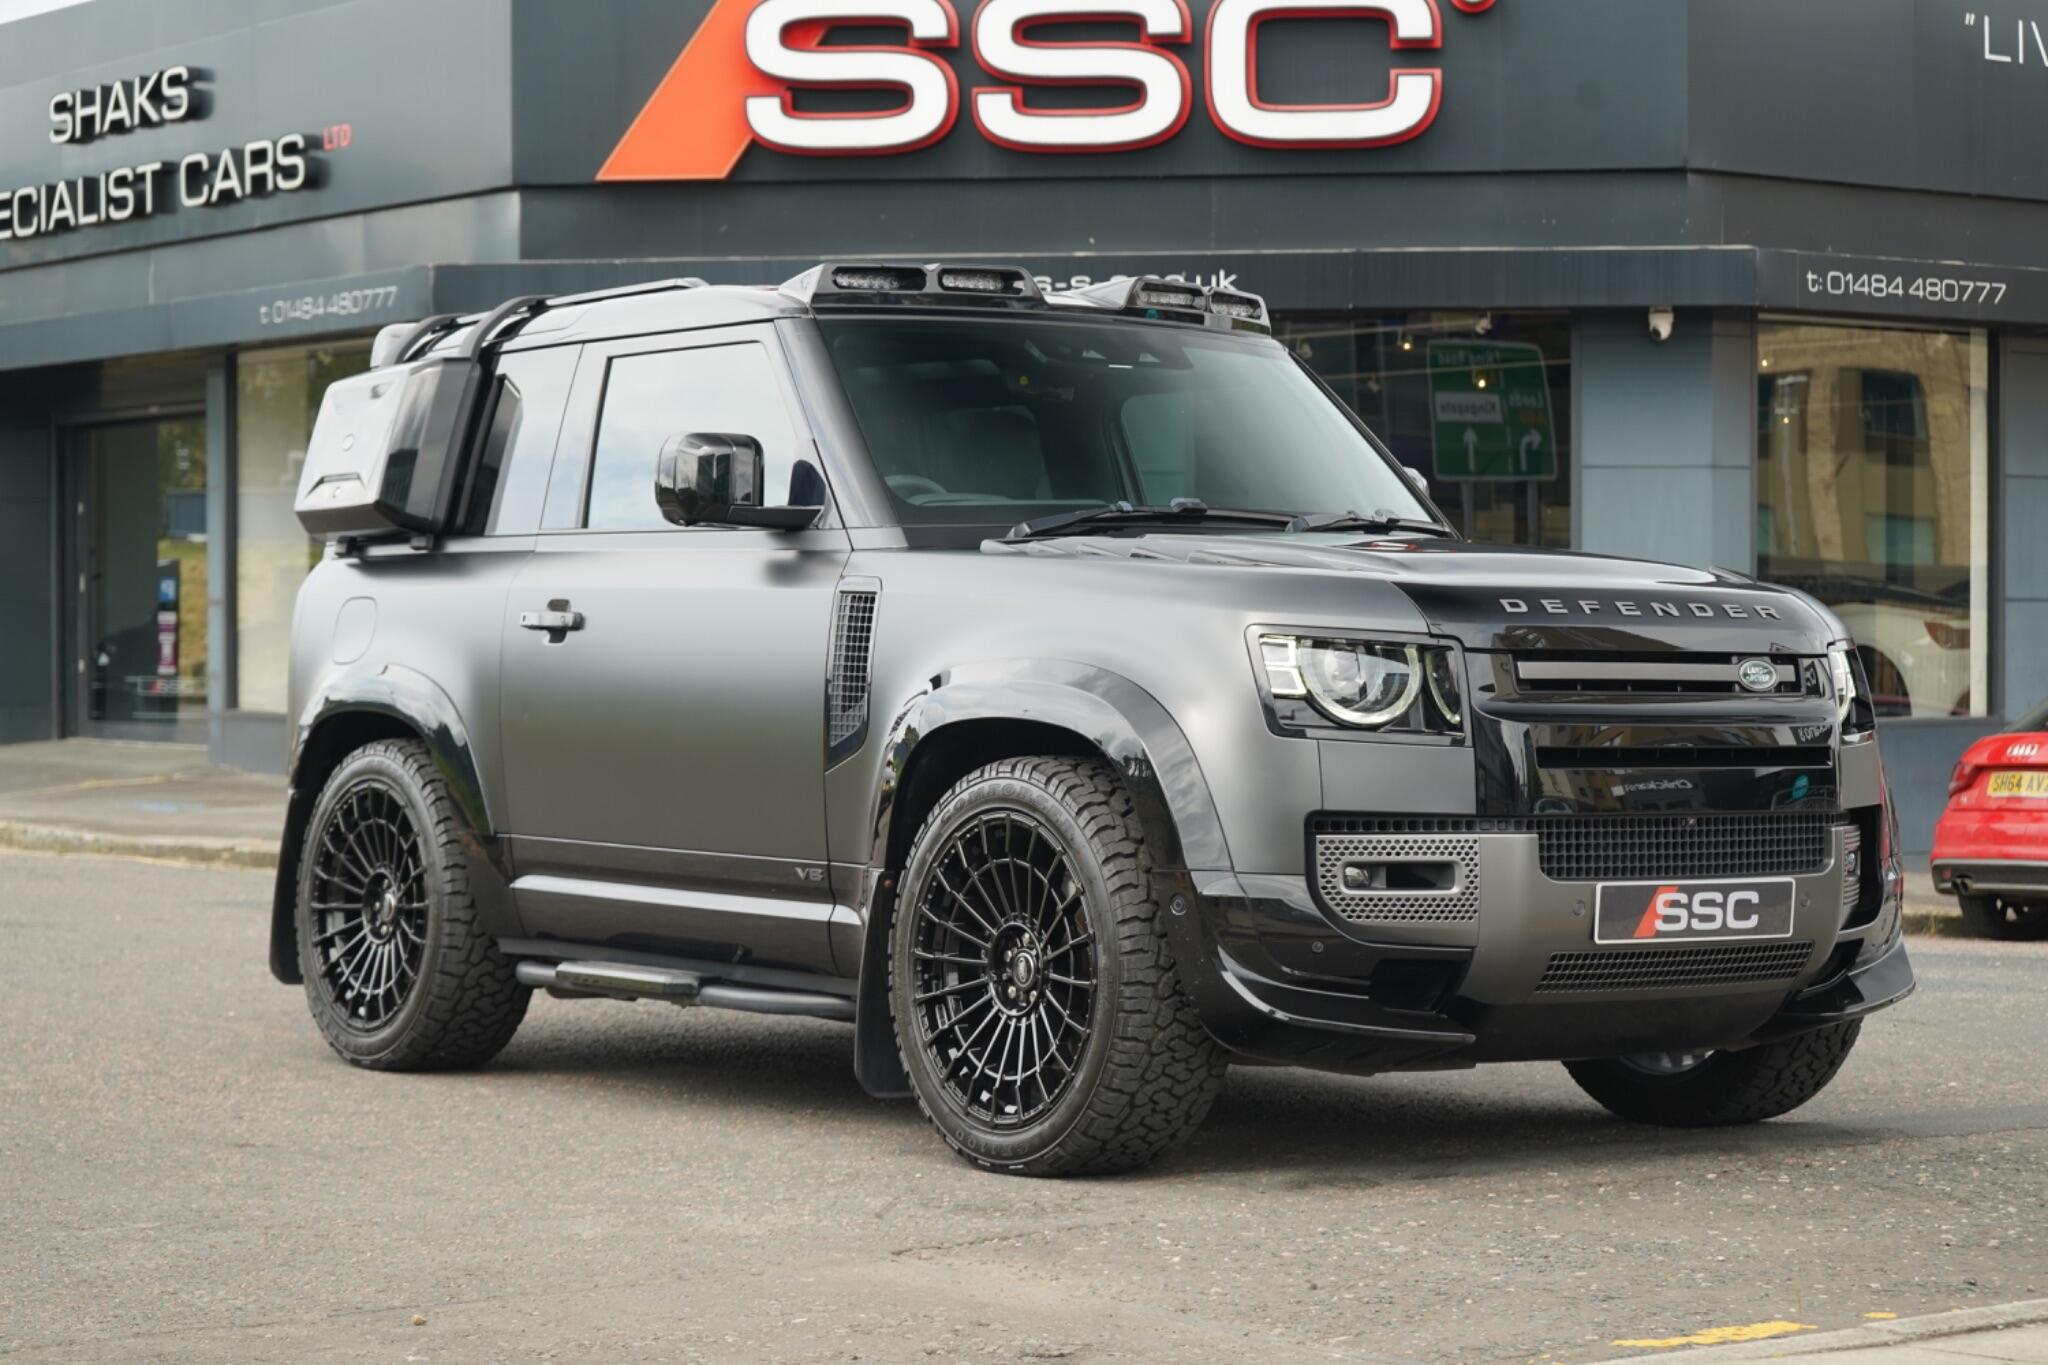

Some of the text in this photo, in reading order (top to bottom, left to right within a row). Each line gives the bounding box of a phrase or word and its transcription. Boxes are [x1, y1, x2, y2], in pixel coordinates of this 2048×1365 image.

[49, 66, 189, 144] SHAKS
[744, 0, 1443, 156] SSC
[179, 133, 306, 208] CARS
[323, 123, 353, 152] LTD
[1499, 598, 1780, 621] DEFENDER
[1992, 773, 2023, 793] SH64
[1654, 891, 1760, 932] SSC
